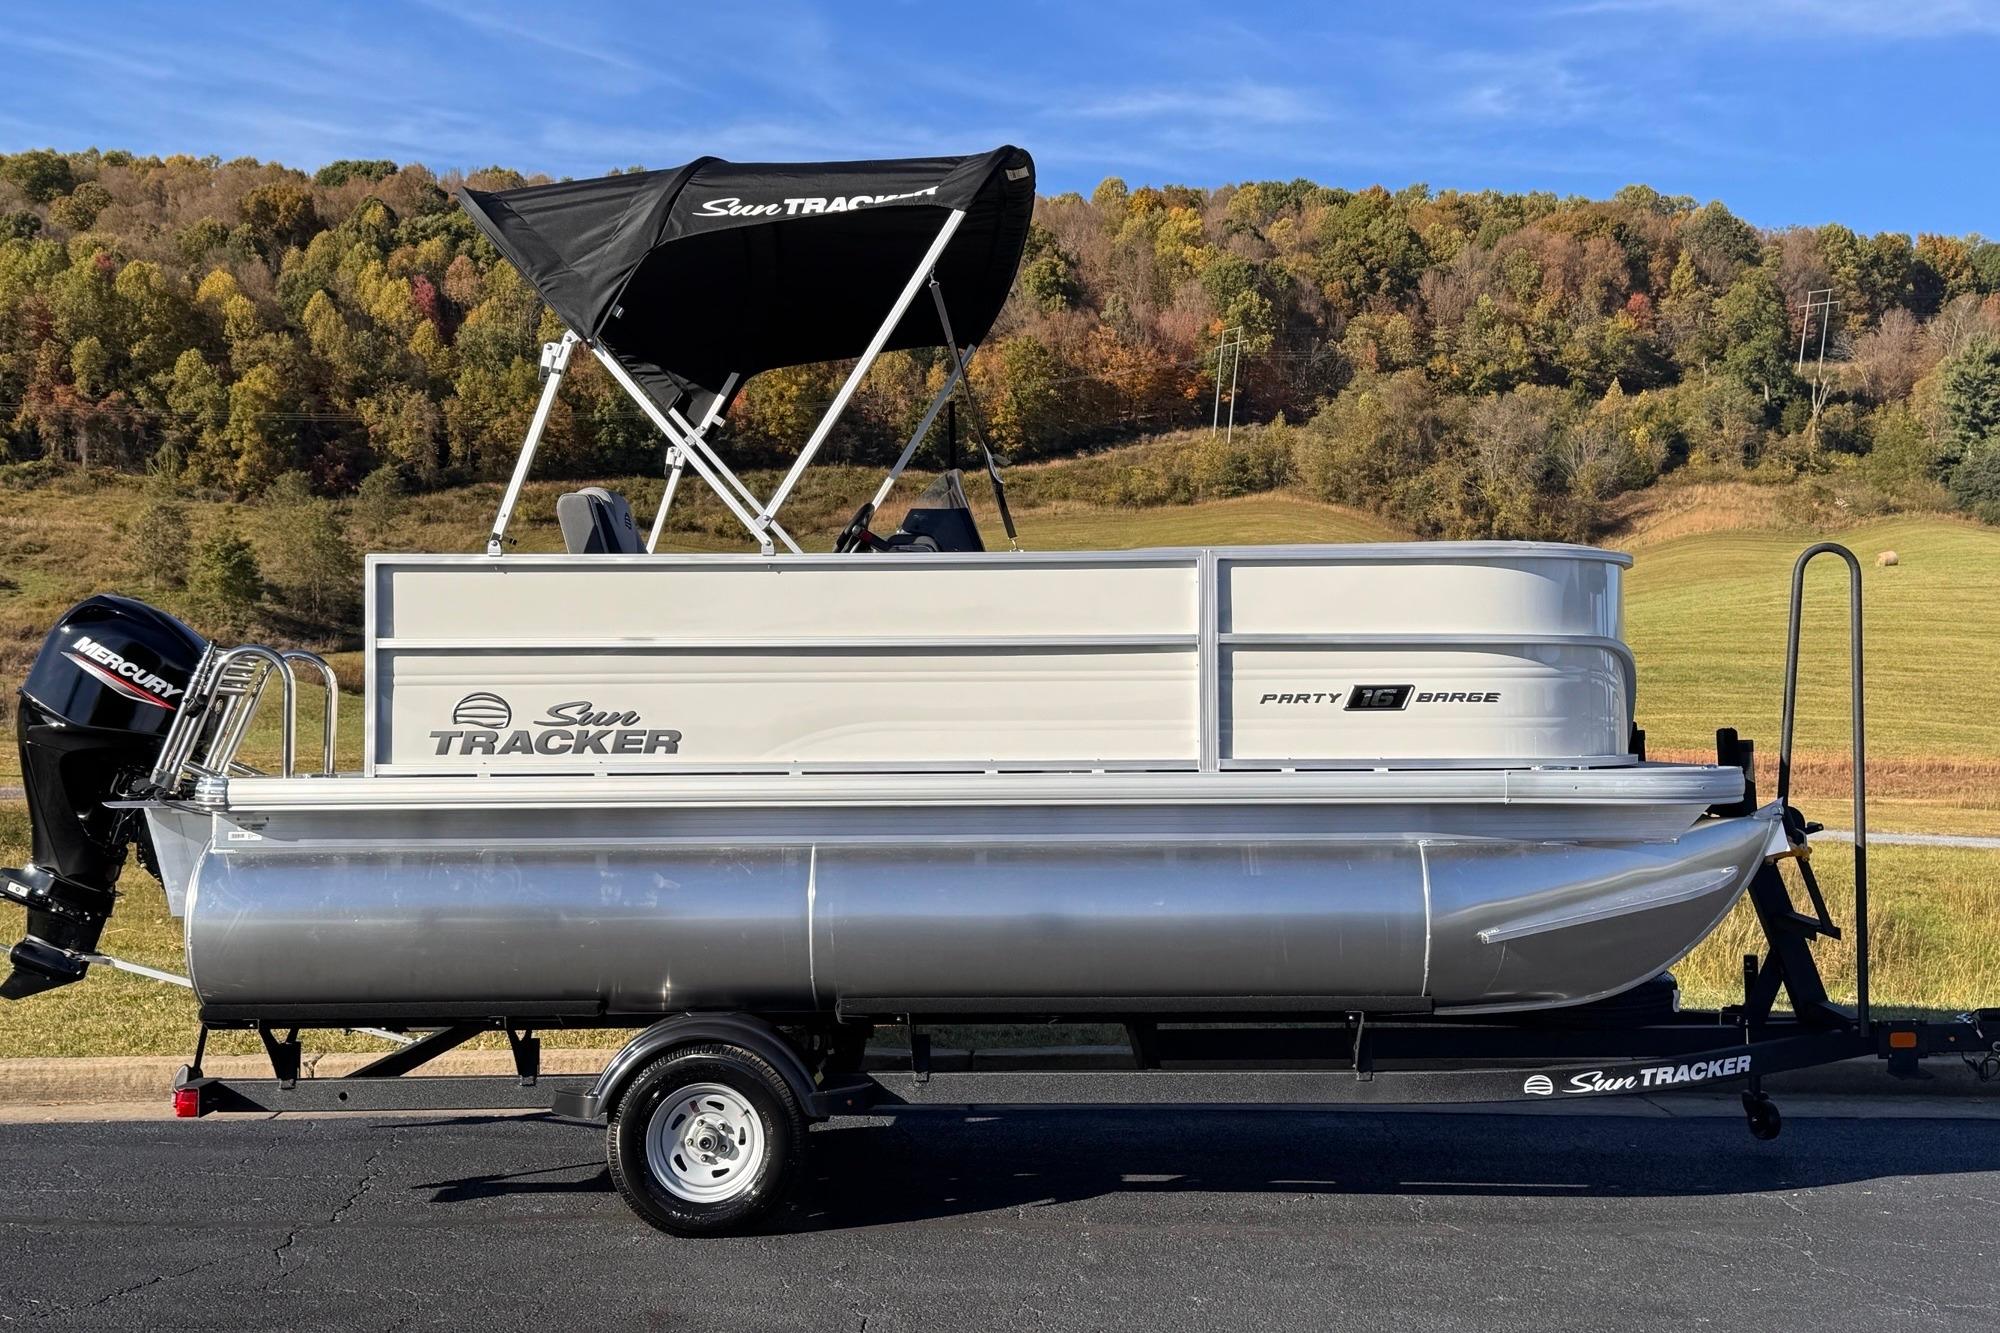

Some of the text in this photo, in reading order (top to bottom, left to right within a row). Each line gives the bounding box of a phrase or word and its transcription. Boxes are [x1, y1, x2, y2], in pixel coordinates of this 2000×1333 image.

[692, 185, 939, 217] Sun TRAC
[72, 636, 185, 698] MERCURY
[1259, 689, 1502, 707] PARTY 16 BARGE
[533, 700, 641, 727] Sun
[429, 729, 683, 756] TRACKER
[1561, 1055, 1752, 1094] Sun TRACKER
